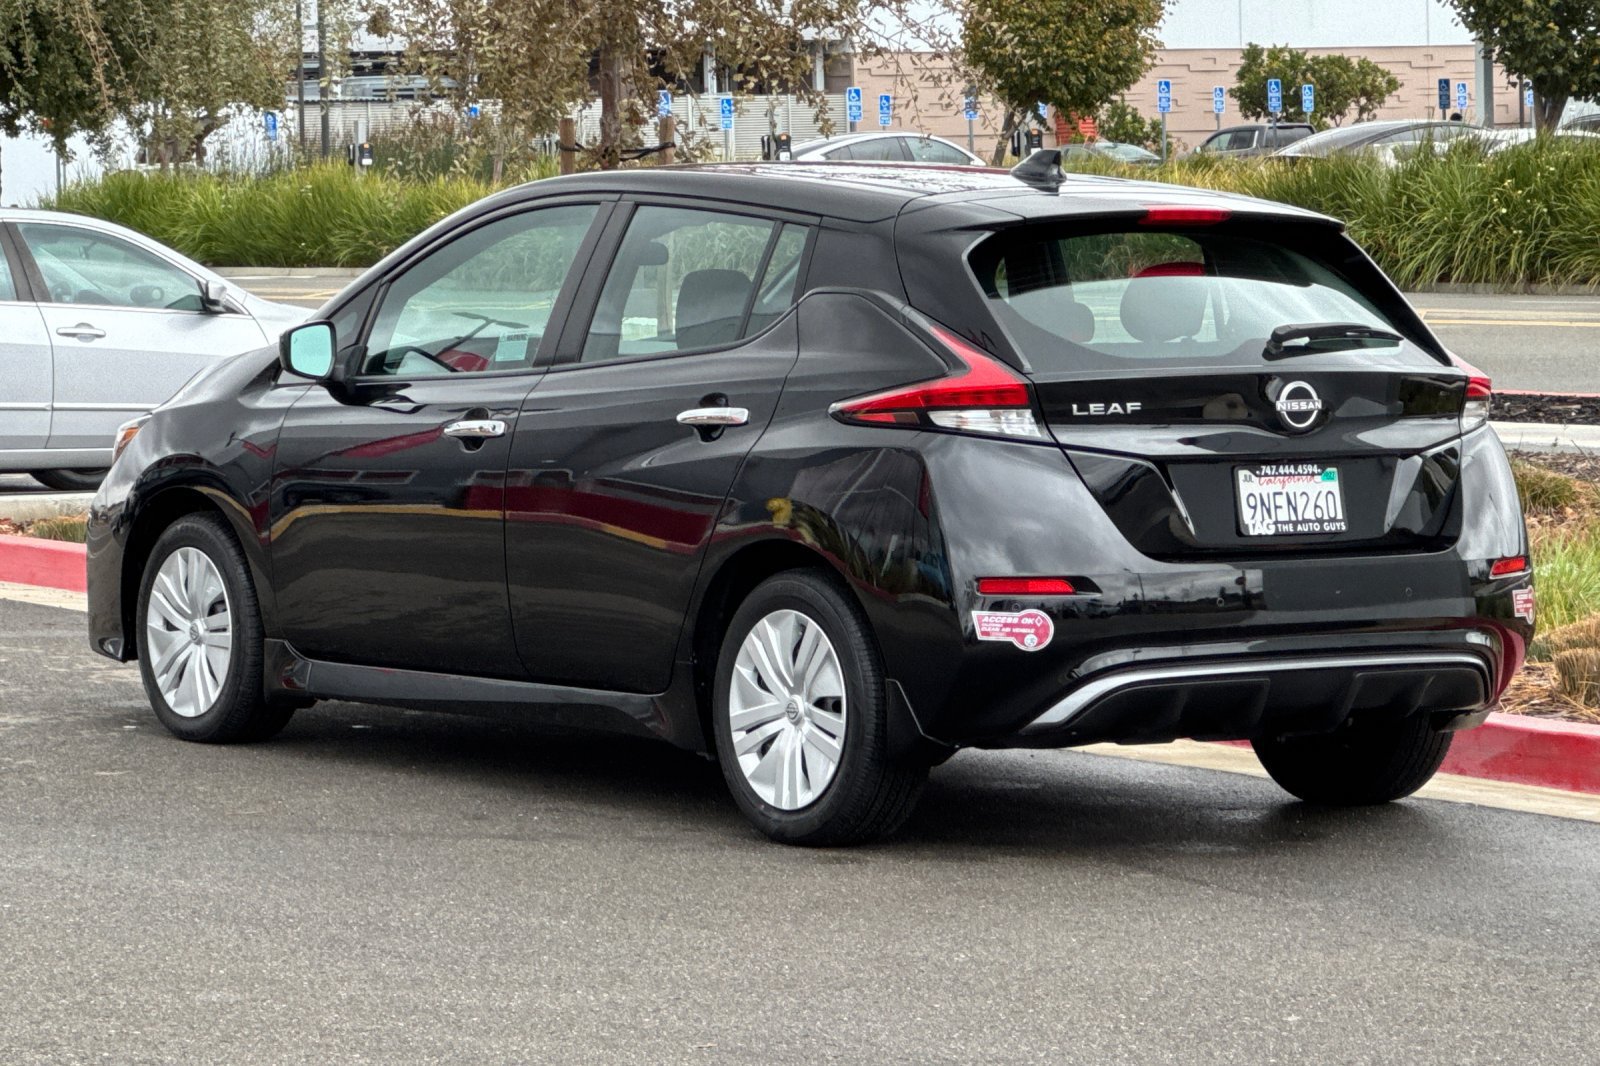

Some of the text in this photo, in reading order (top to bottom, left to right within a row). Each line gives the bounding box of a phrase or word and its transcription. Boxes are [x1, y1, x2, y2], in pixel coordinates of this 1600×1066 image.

[1072, 402, 1142, 416] LEAF
[1277, 401, 1322, 411] NISSAN
[1246, 520, 1346, 536] TAG THE AUTO GUYS
[982, 616, 1035, 625] ACCESS OK
